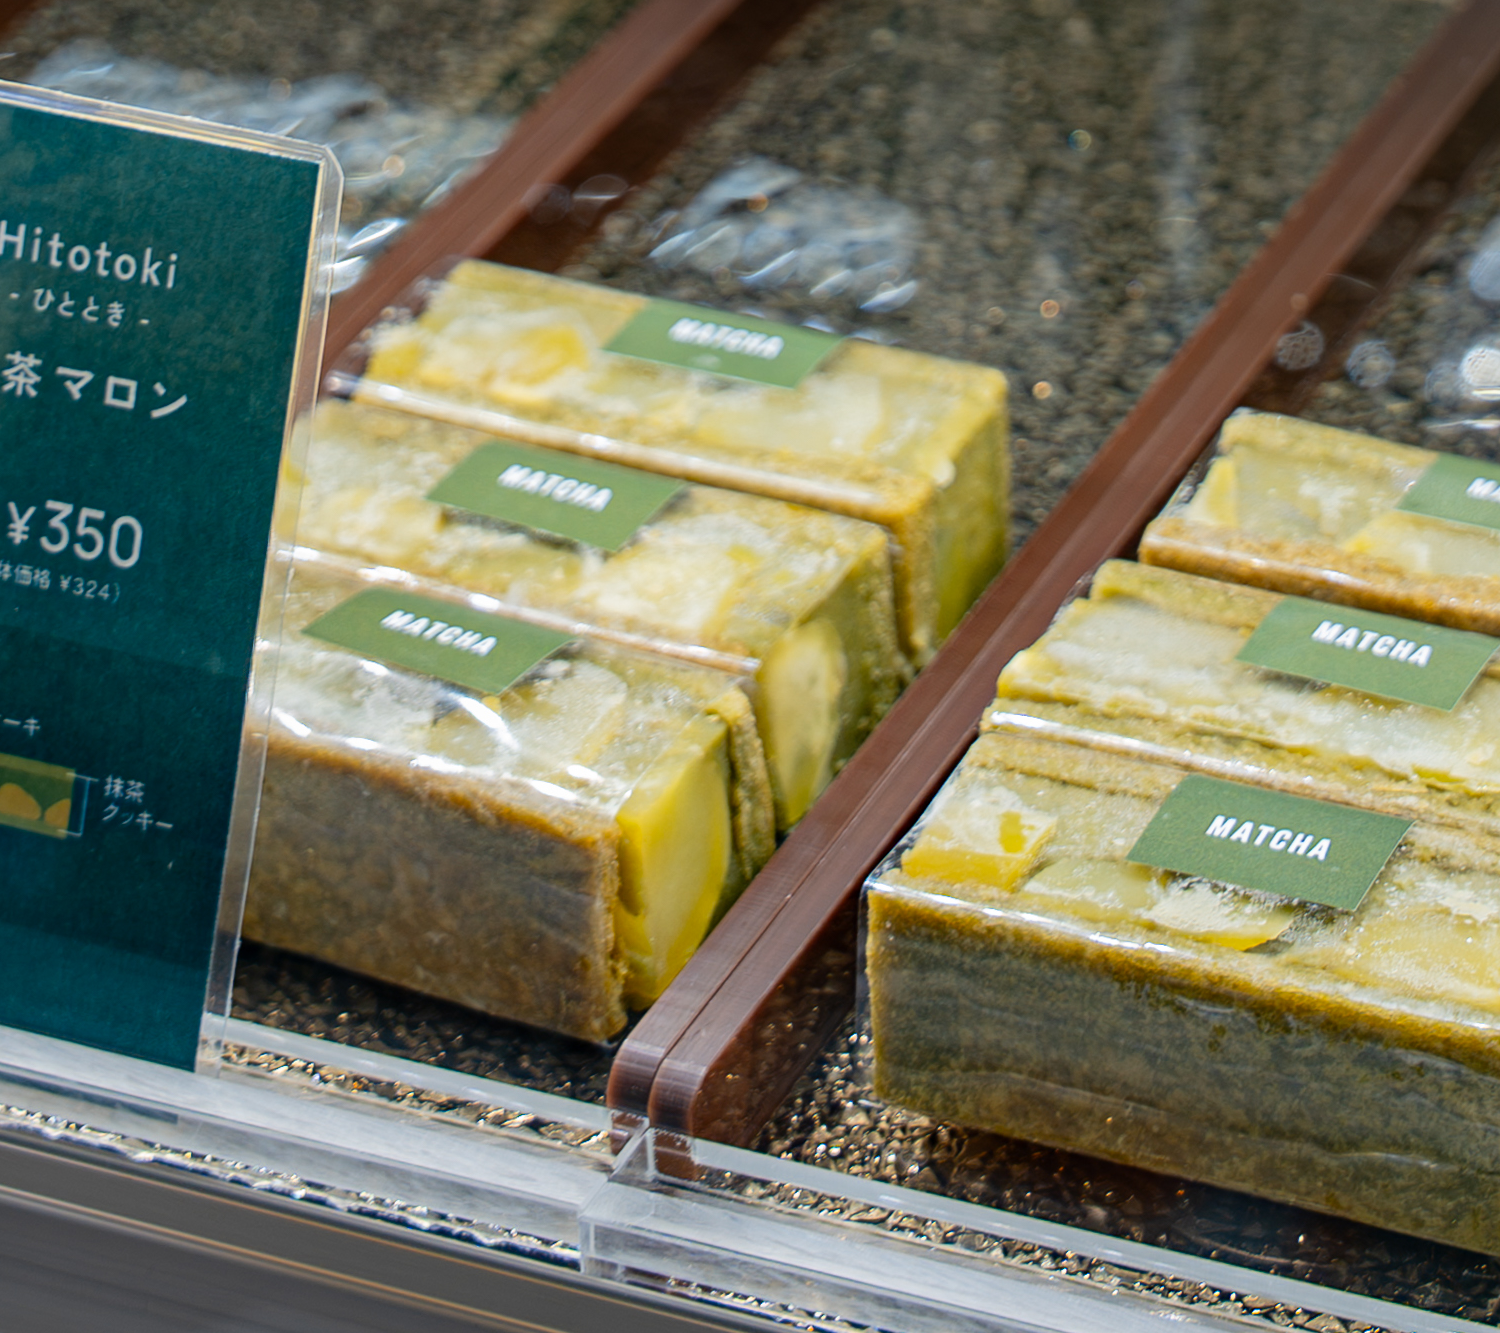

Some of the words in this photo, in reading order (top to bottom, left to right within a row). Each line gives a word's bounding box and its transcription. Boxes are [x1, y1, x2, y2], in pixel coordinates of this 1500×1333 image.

[668, 317, 784, 360] MATCHA
[498, 463, 613, 512] MATCHA
[7, 499, 143, 569] ¥350
[380, 609, 498, 657] MATCHA
[1312, 620, 1432, 668] MATCHA
[1206, 814, 1332, 862] MATCHA
